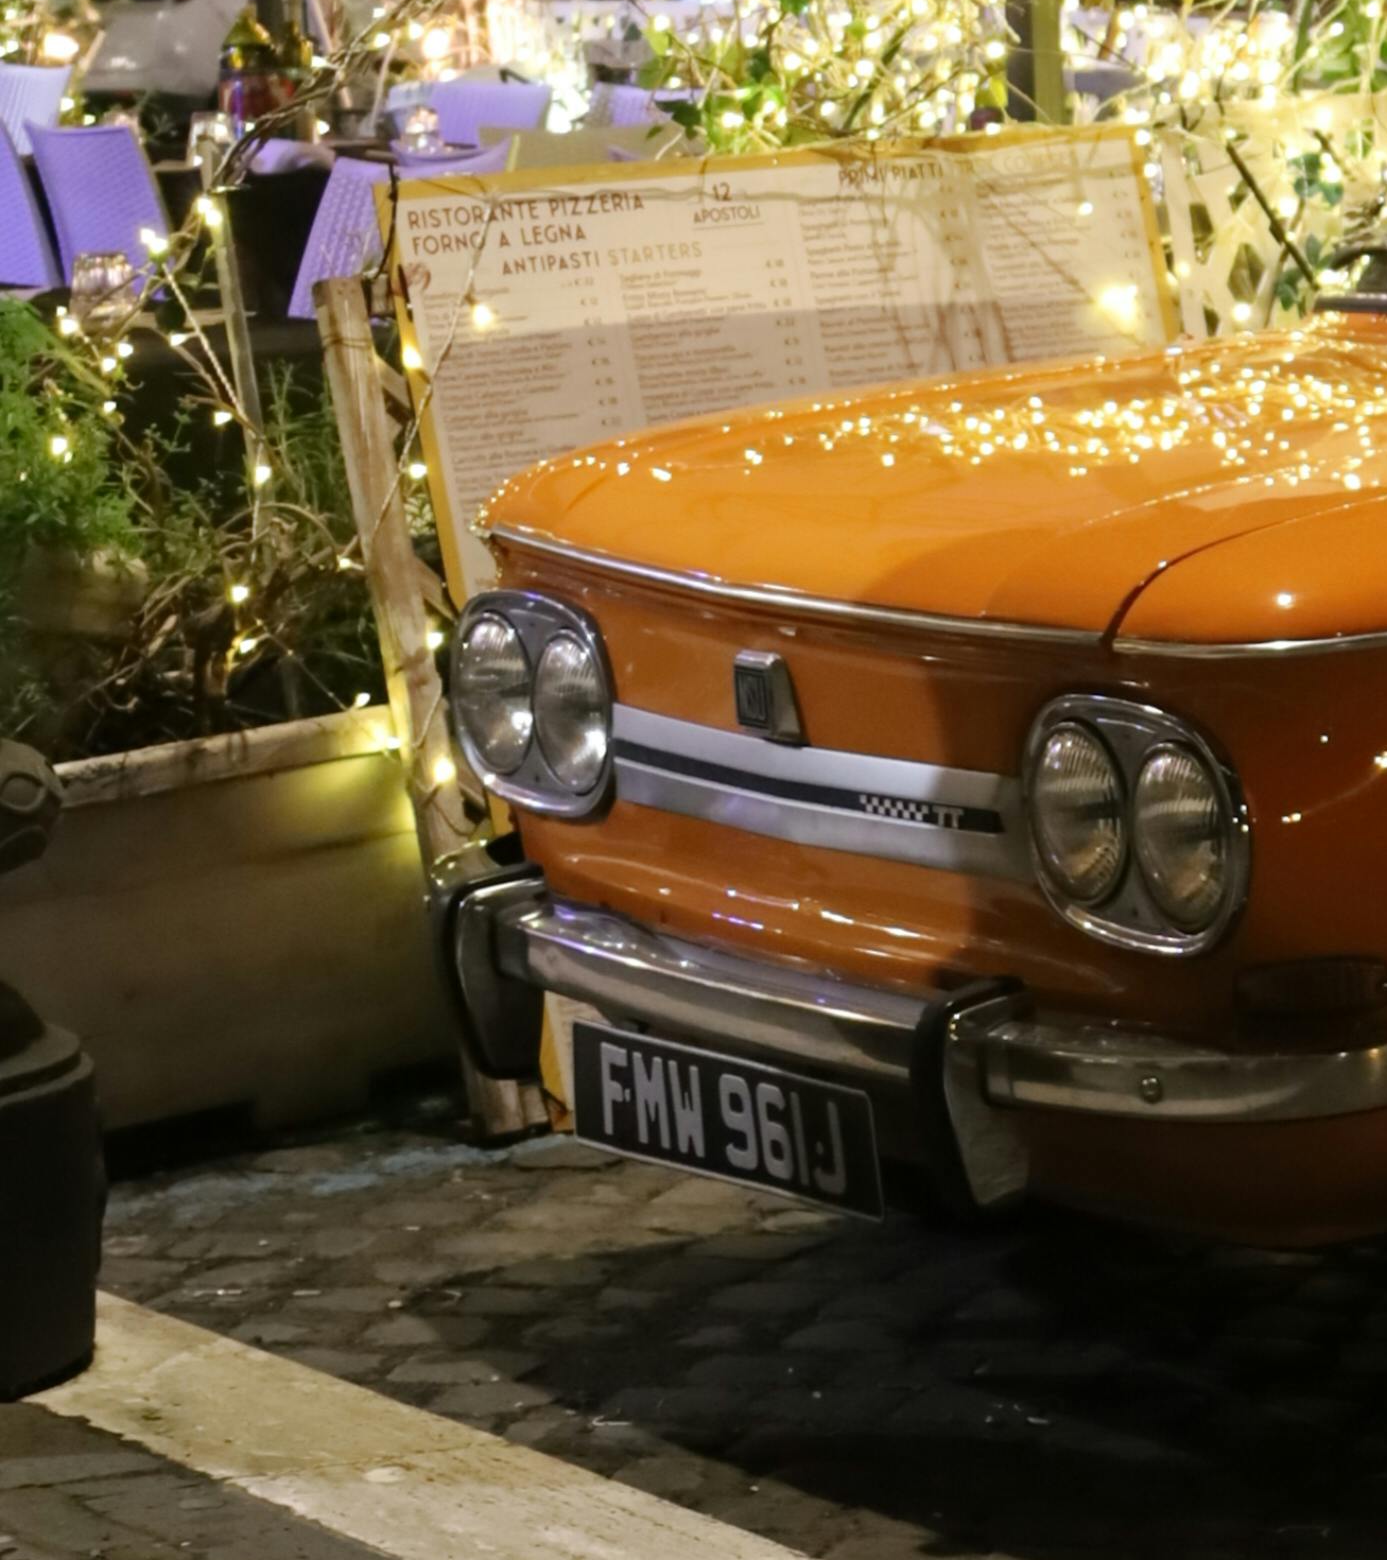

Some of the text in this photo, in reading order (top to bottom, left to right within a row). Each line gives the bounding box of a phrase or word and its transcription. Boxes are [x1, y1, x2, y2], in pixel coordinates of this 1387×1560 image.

[892, 162, 944, 182] PIATTI
[712, 182, 732, 202] 12
[407, 190, 645, 231] RISTORANTE PIZZERIA
[693, 205, 761, 224] APOSTOLI
[411, 224, 587, 257] FORNO A LEGNA
[502, 241, 704, 276] ANTIPASTI STARTERS
[600, 1041, 846, 1196] FMW 961J
